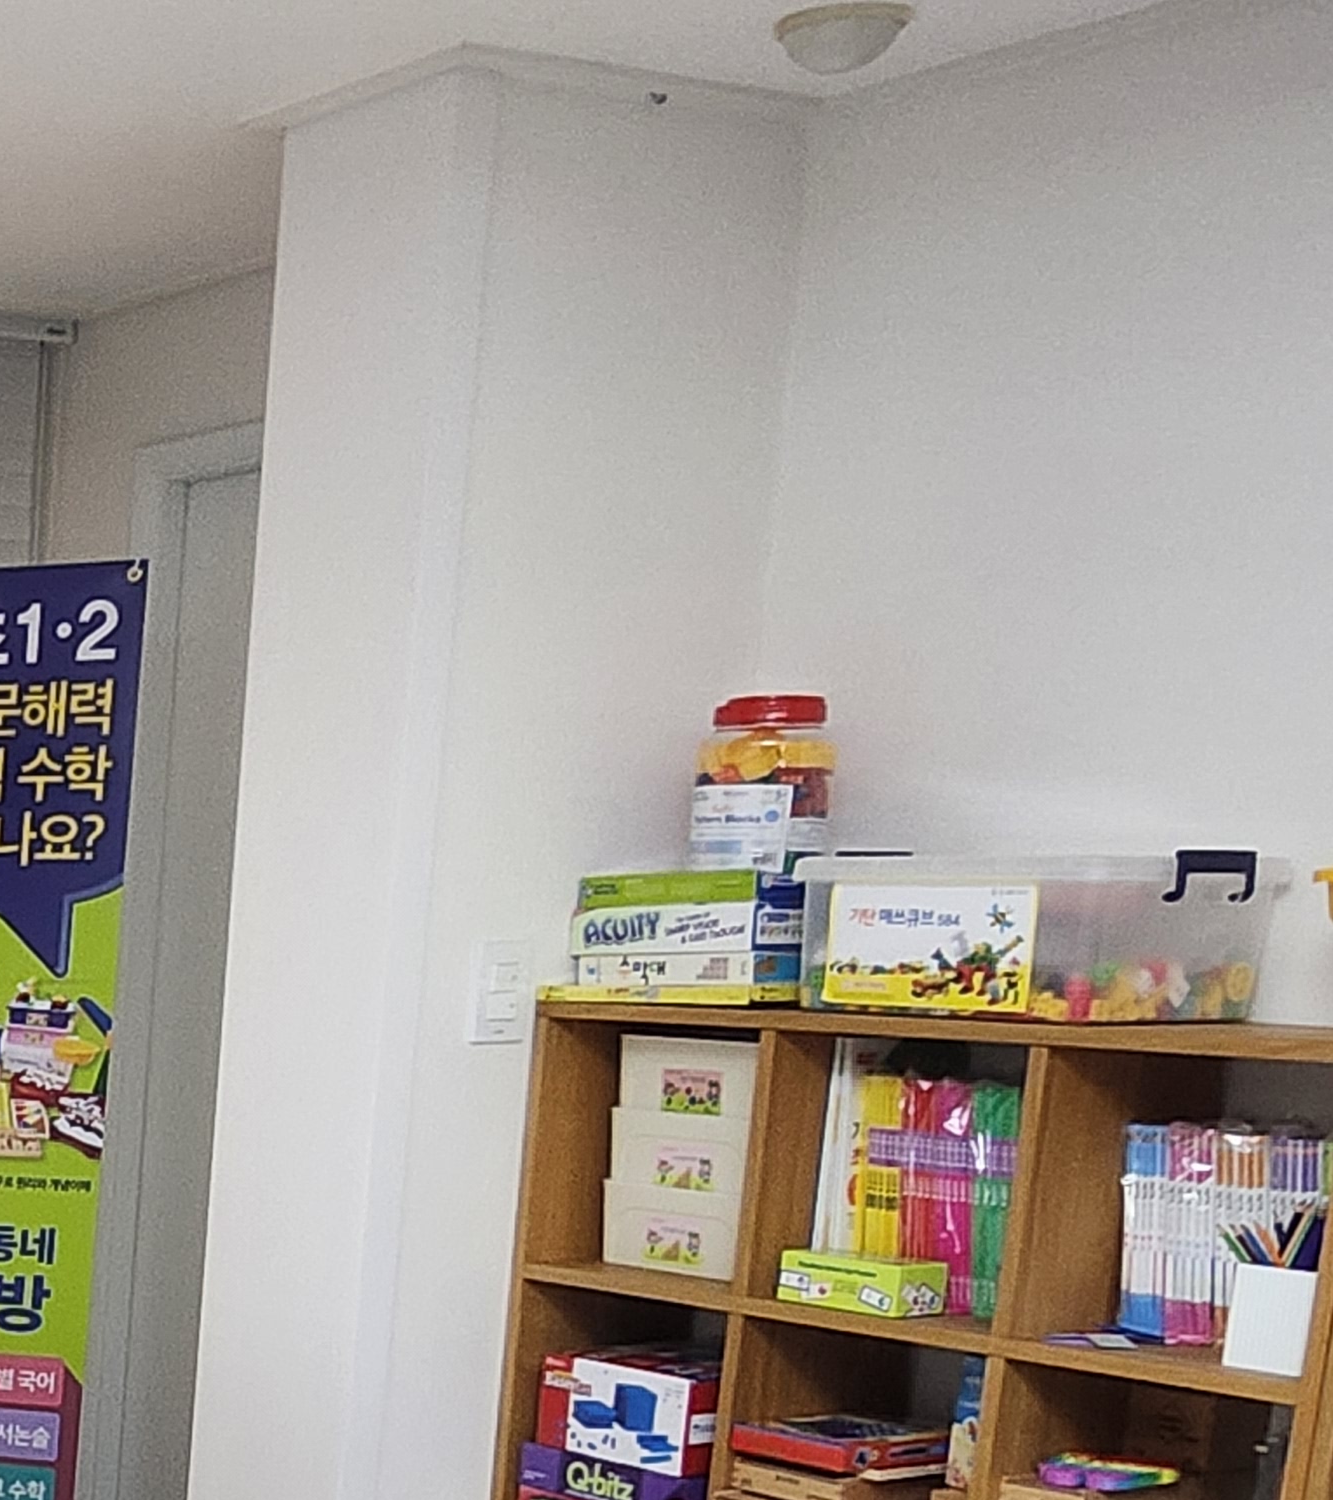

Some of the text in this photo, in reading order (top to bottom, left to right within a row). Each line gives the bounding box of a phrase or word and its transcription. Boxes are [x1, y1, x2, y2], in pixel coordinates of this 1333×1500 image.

[17, 744, 113, 803] 수학
[584, 911, 661, 946] ACUITY
[848, 908, 876, 927] 기탄
[879, 908, 934, 928] 매쓰큐브
[17, 1370, 55, 1394] 국어
